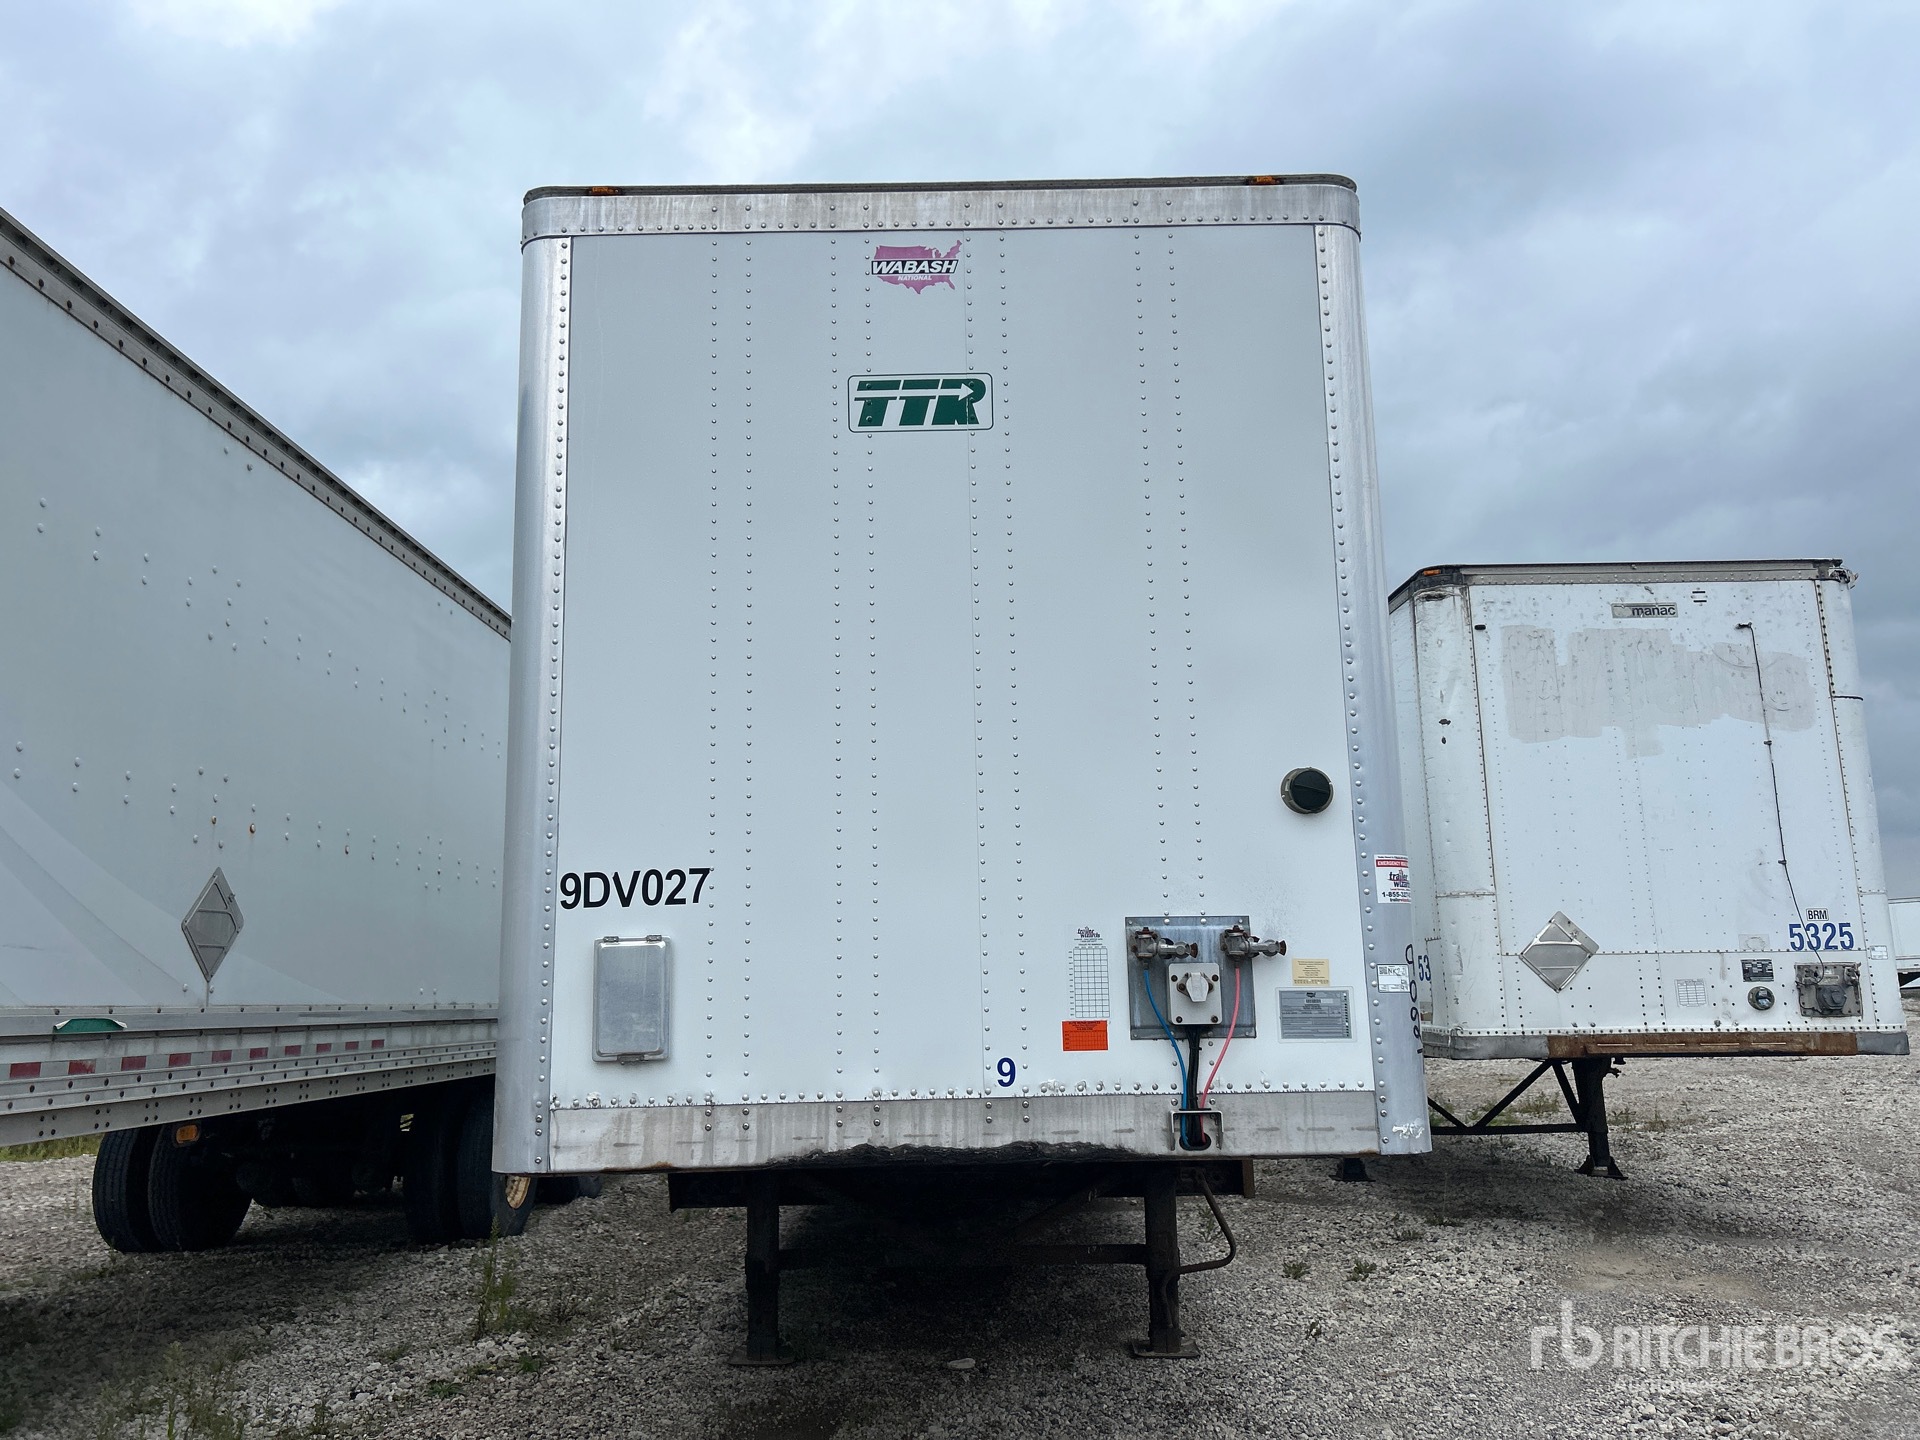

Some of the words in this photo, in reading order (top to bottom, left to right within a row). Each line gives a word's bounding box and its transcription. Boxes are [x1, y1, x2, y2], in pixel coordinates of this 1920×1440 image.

[873, 260, 958, 274] WABASH
[854, 378, 986, 427] TTR
[1631, 606, 1676, 616] manac
[560, 867, 711, 910] 9DV027
[1807, 910, 1828, 920] BRM
[1788, 922, 1855, 951] 5325
[997, 1057, 1016, 1087] 9
